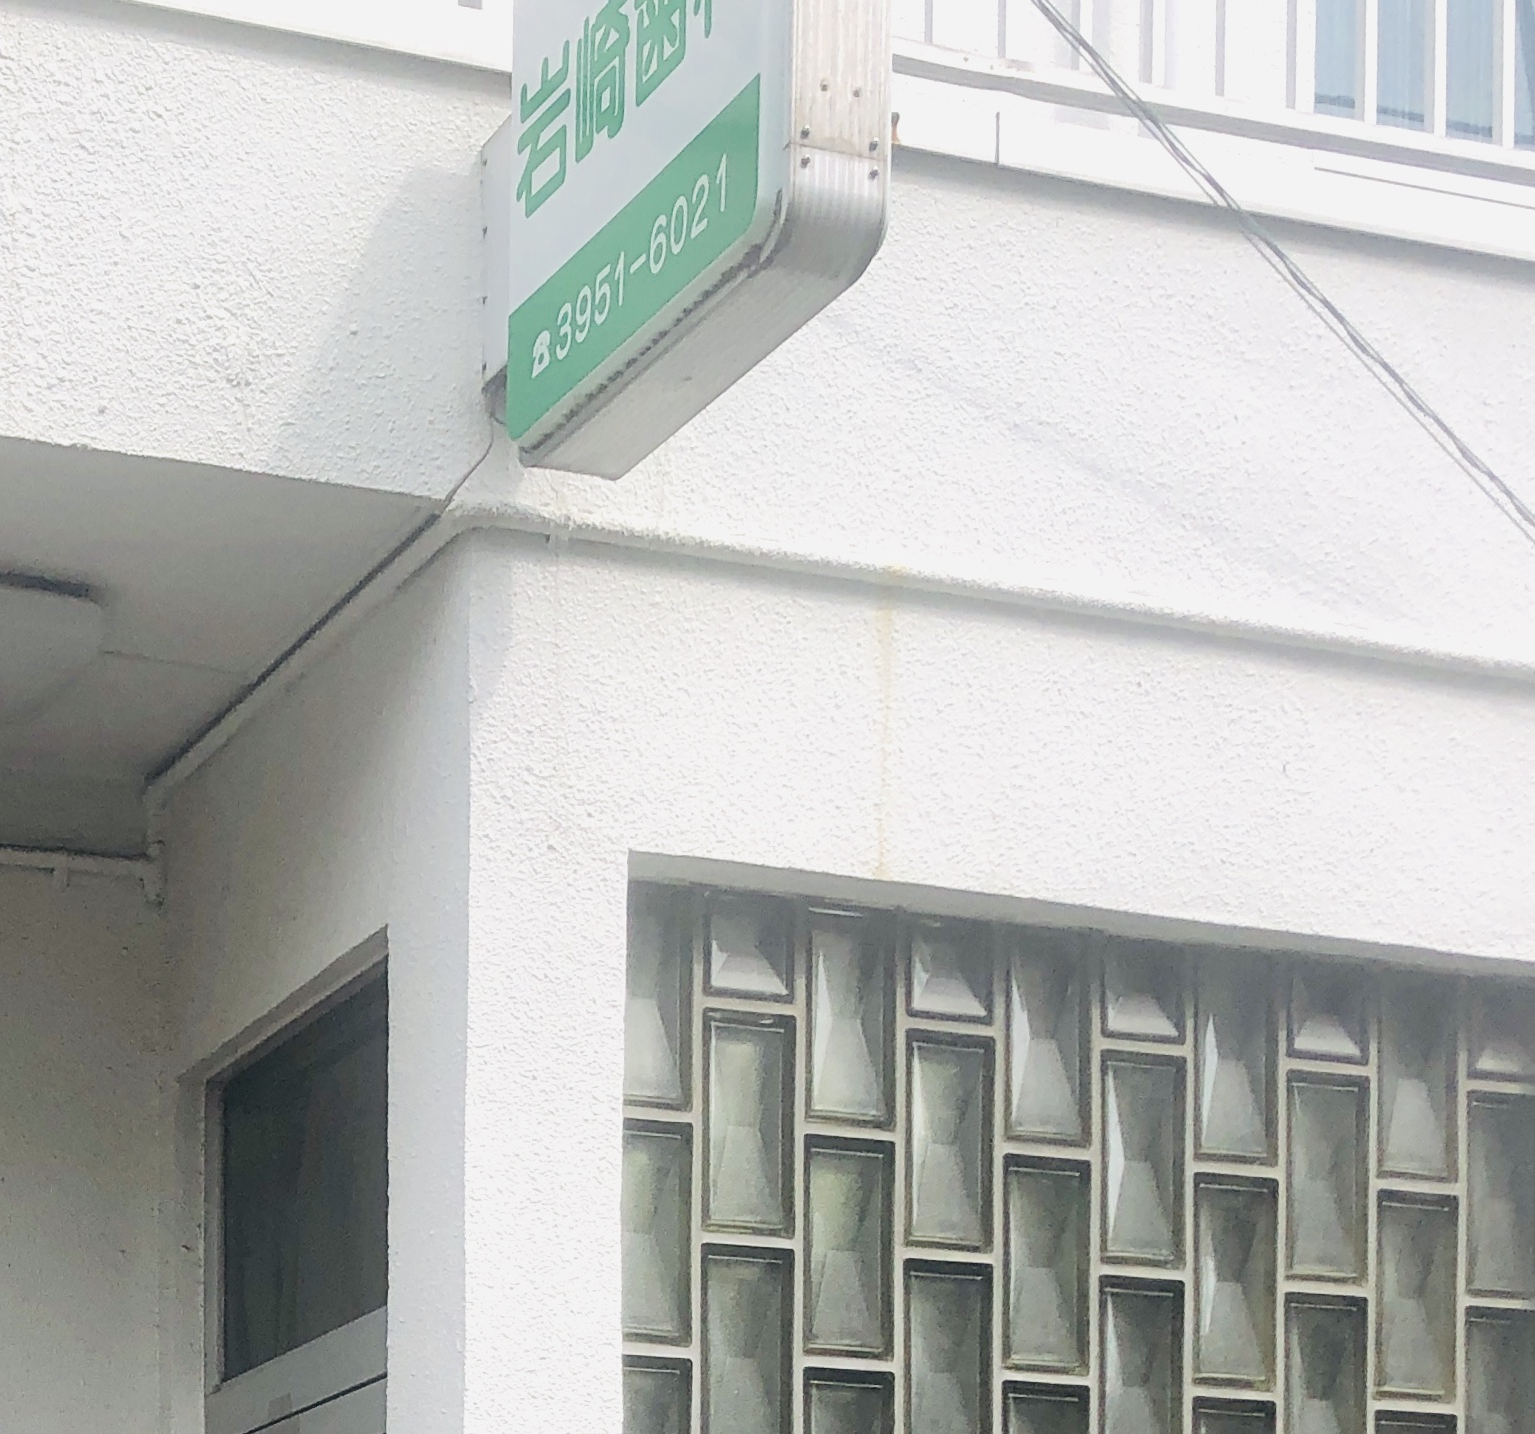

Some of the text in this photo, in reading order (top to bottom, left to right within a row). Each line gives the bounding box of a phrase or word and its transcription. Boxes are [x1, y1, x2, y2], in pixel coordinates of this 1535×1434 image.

[516, 0, 712, 220] 岩崎歯
[555, 153, 727, 361] 3951-6021
